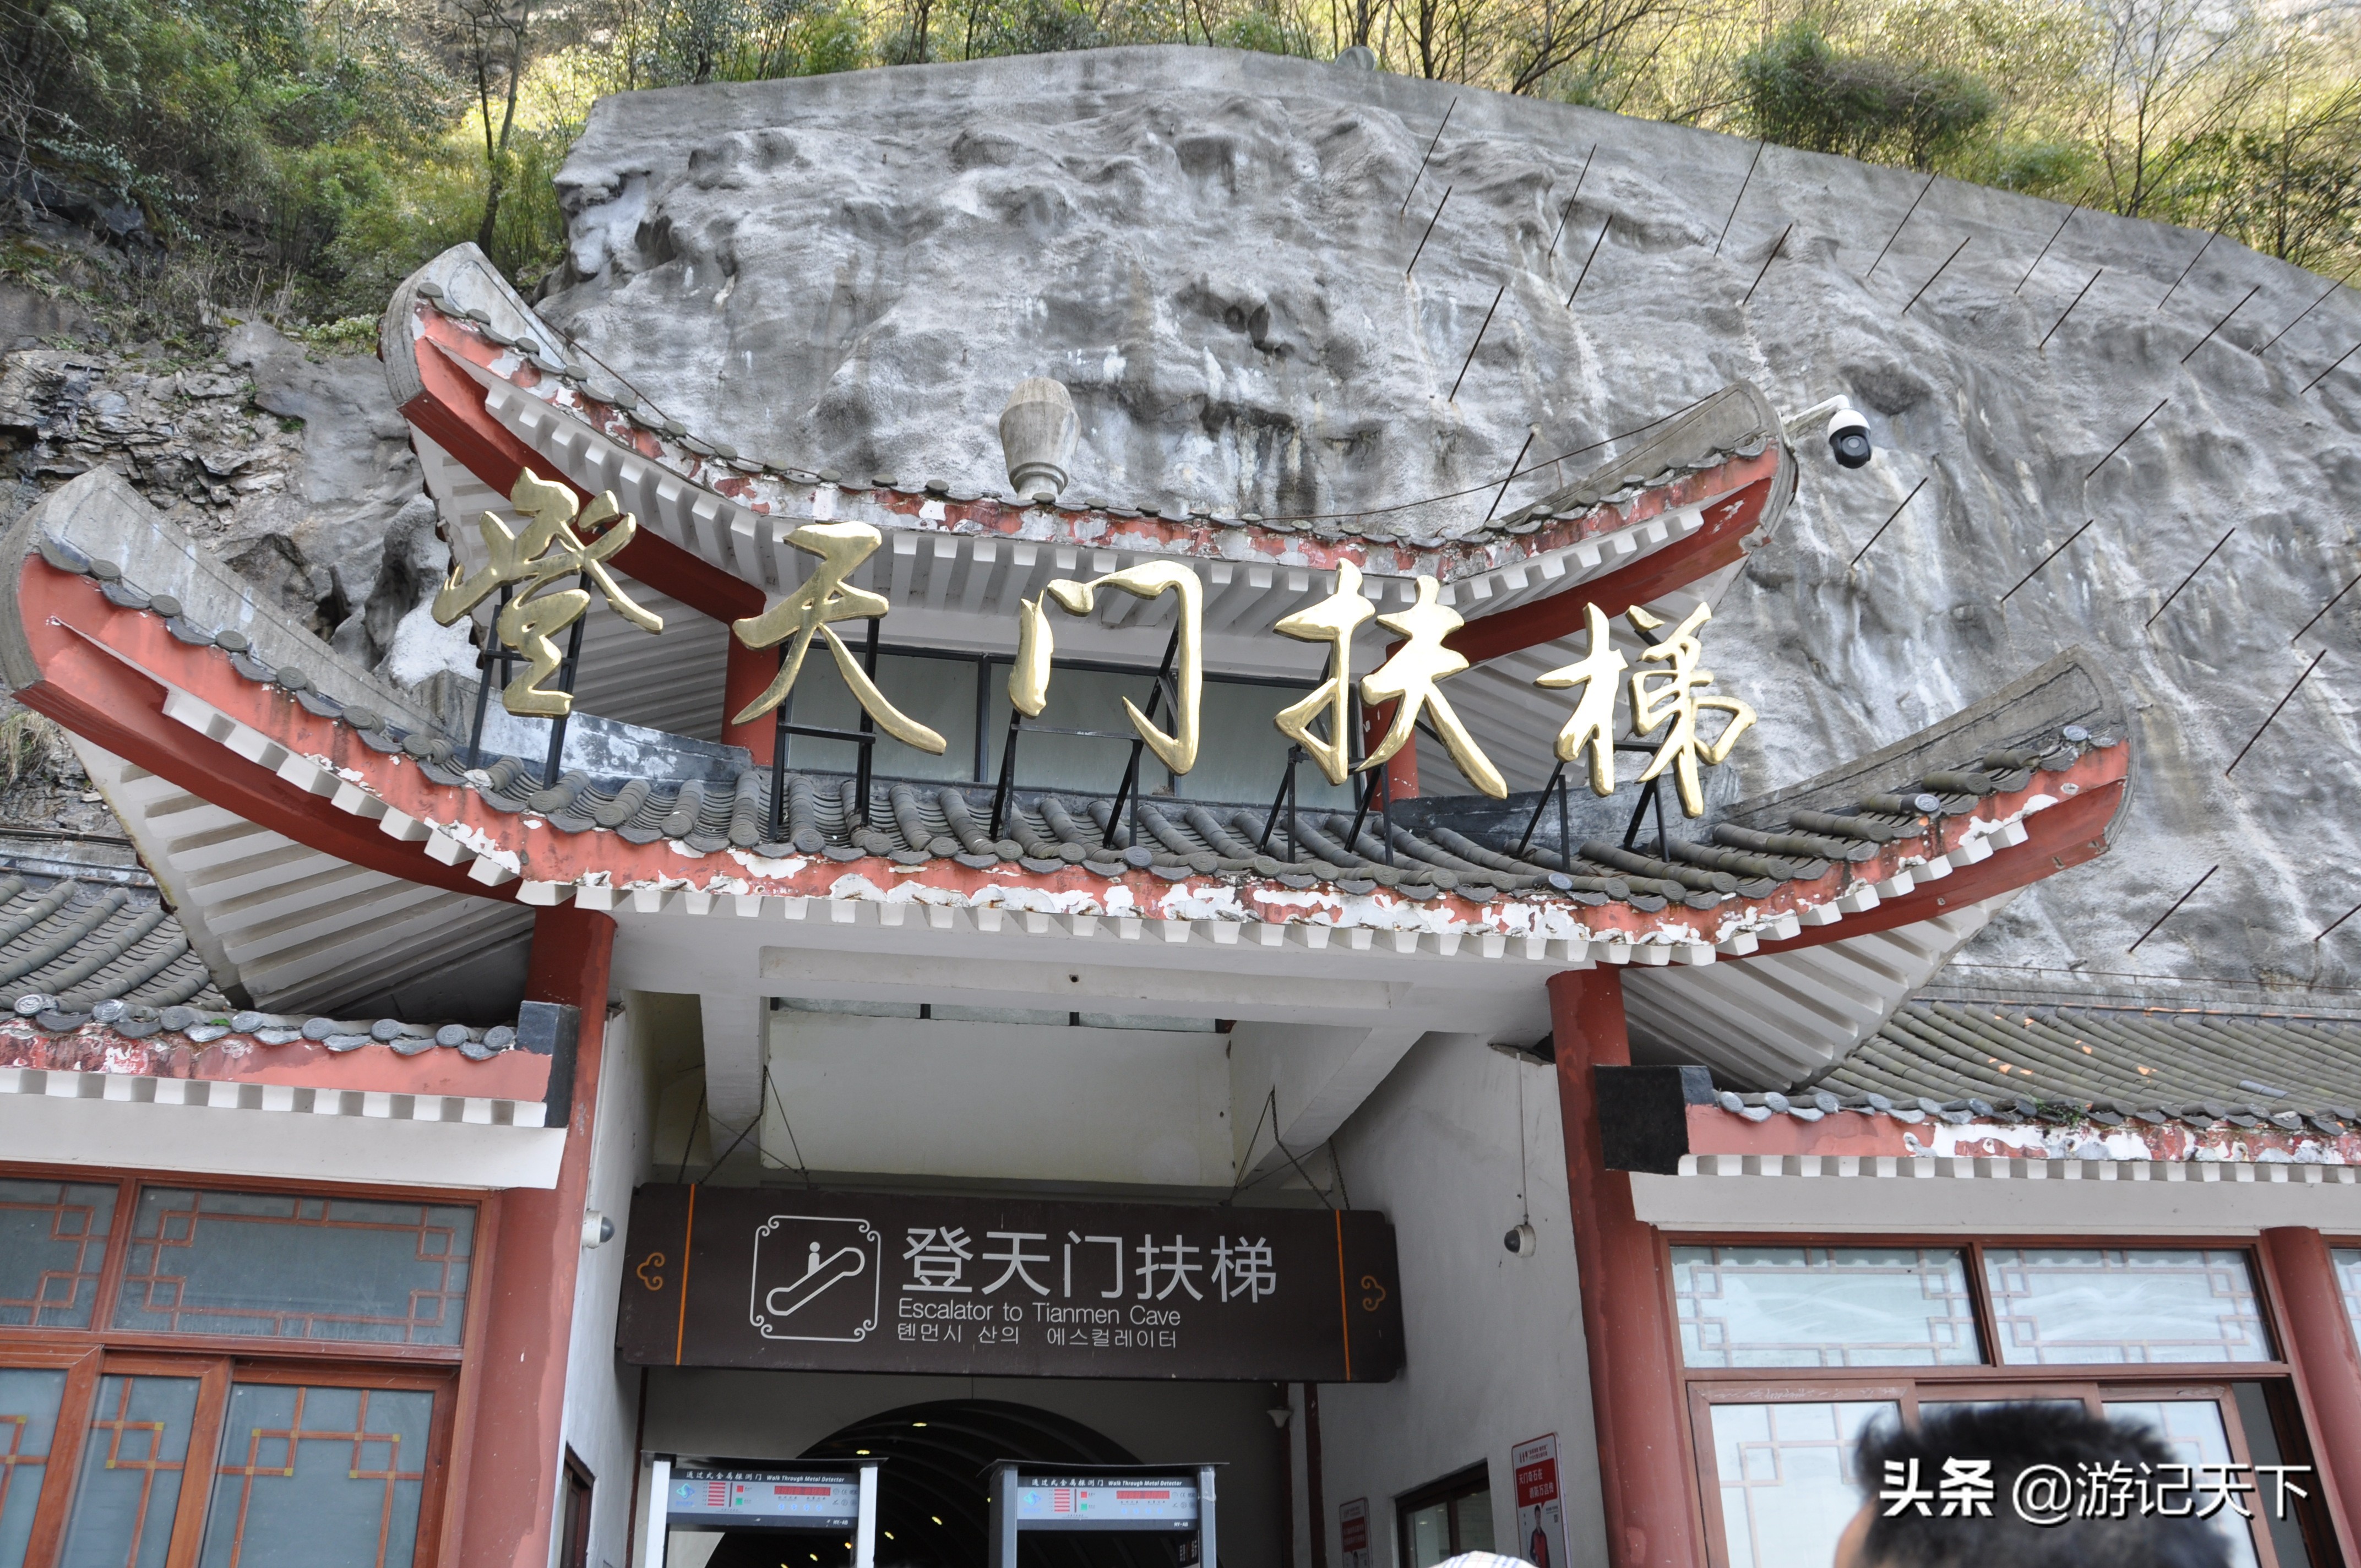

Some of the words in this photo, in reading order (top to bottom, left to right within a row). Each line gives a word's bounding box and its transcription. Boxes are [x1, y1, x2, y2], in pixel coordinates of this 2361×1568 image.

[431, 467, 1758, 818] 登天门扶梯
[902, 1226, 1278, 1303] 登天门扶梯
[899, 1298, 994, 1321] Escalator
[1003, 1302, 1023, 1321] to
[1032, 1302, 1119, 1324] Tianmen
[1130, 1305, 1181, 1325] Cave
[897, 1323, 962, 1343] 톈먼시
[978, 1326, 1019, 1344] 산의
[1047, 1327, 1176, 1348] 에스컬레이터
[686, 1471, 762, 1481] 通过式金属探测门
[1032, 1478, 1103, 1487] 通过式金属探测门
